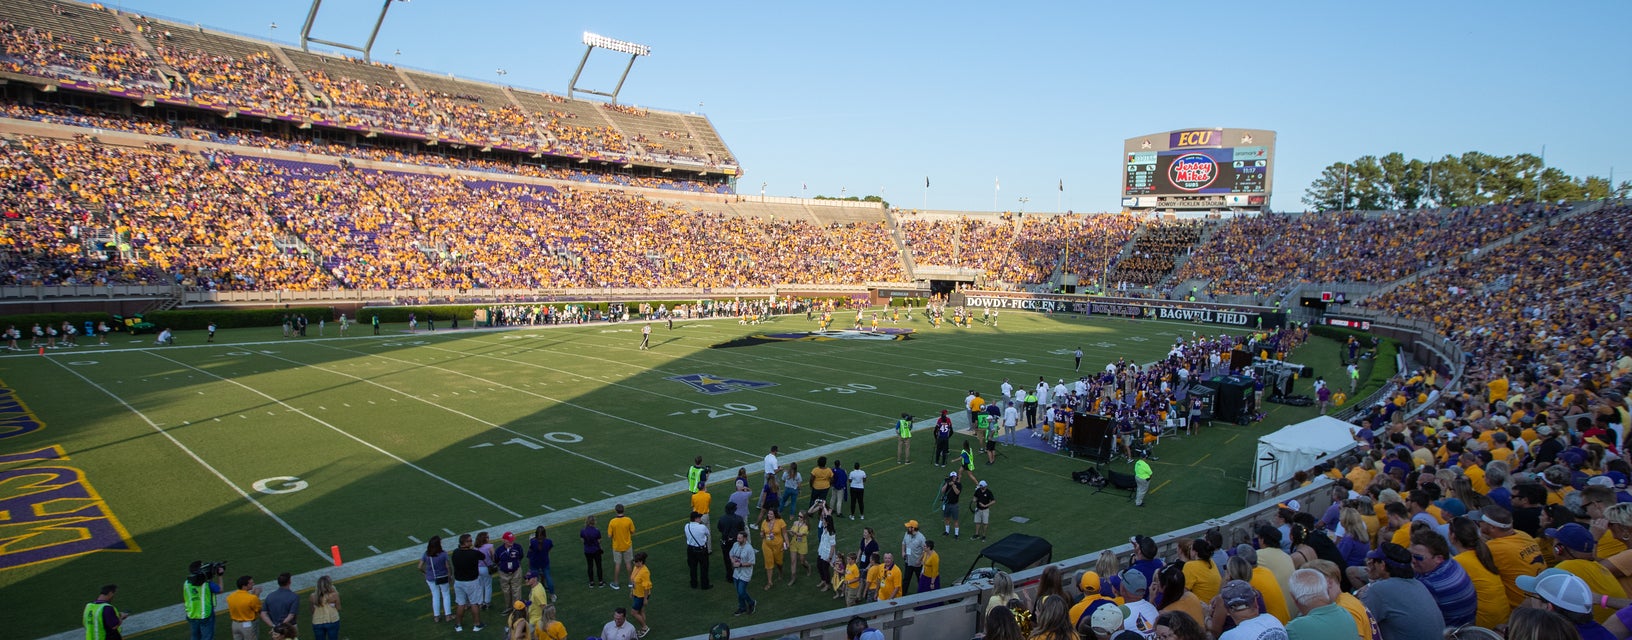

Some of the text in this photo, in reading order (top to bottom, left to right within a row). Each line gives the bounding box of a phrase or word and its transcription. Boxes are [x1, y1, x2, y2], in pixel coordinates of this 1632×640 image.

[1178, 131, 1212, 146] ECU
[1175, 160, 1211, 172] Jersey
[1160, 308, 1248, 325] BAGWELL FIELD
[824, 383, 878, 395] 30
[691, 403, 758, 419] 20
[940, 424, 949, 433] 45
[502, 431, 584, 450] 10
[252, 476, 309, 494] G
